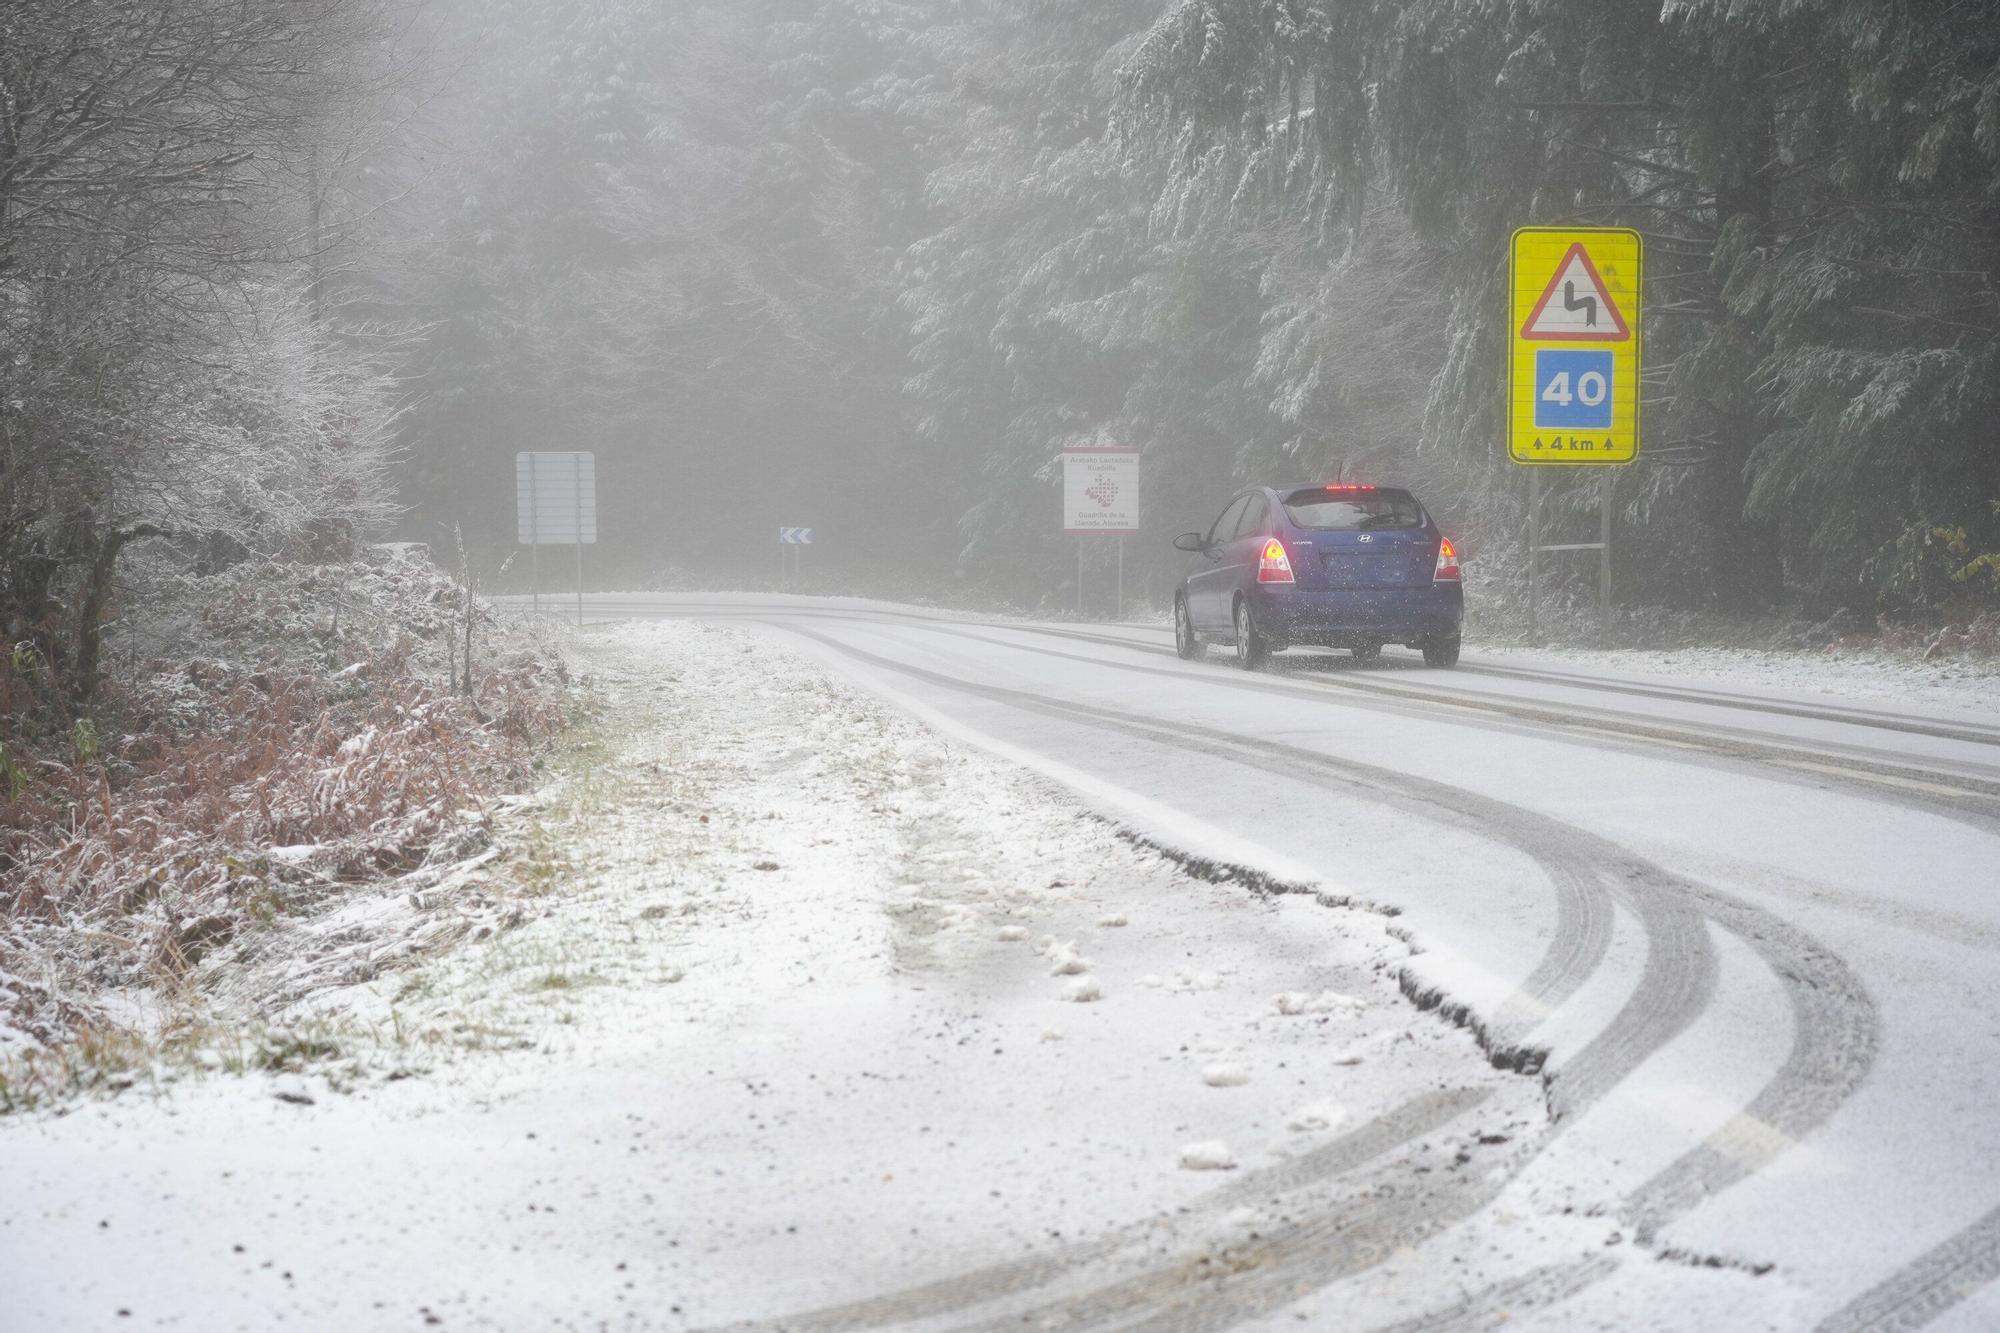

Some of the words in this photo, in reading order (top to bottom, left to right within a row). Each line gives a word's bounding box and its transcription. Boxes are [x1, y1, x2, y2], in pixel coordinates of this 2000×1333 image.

[1542, 371, 1607, 407] 40
[1550, 436, 1563, 451] 4
[1569, 436, 1594, 451] km
